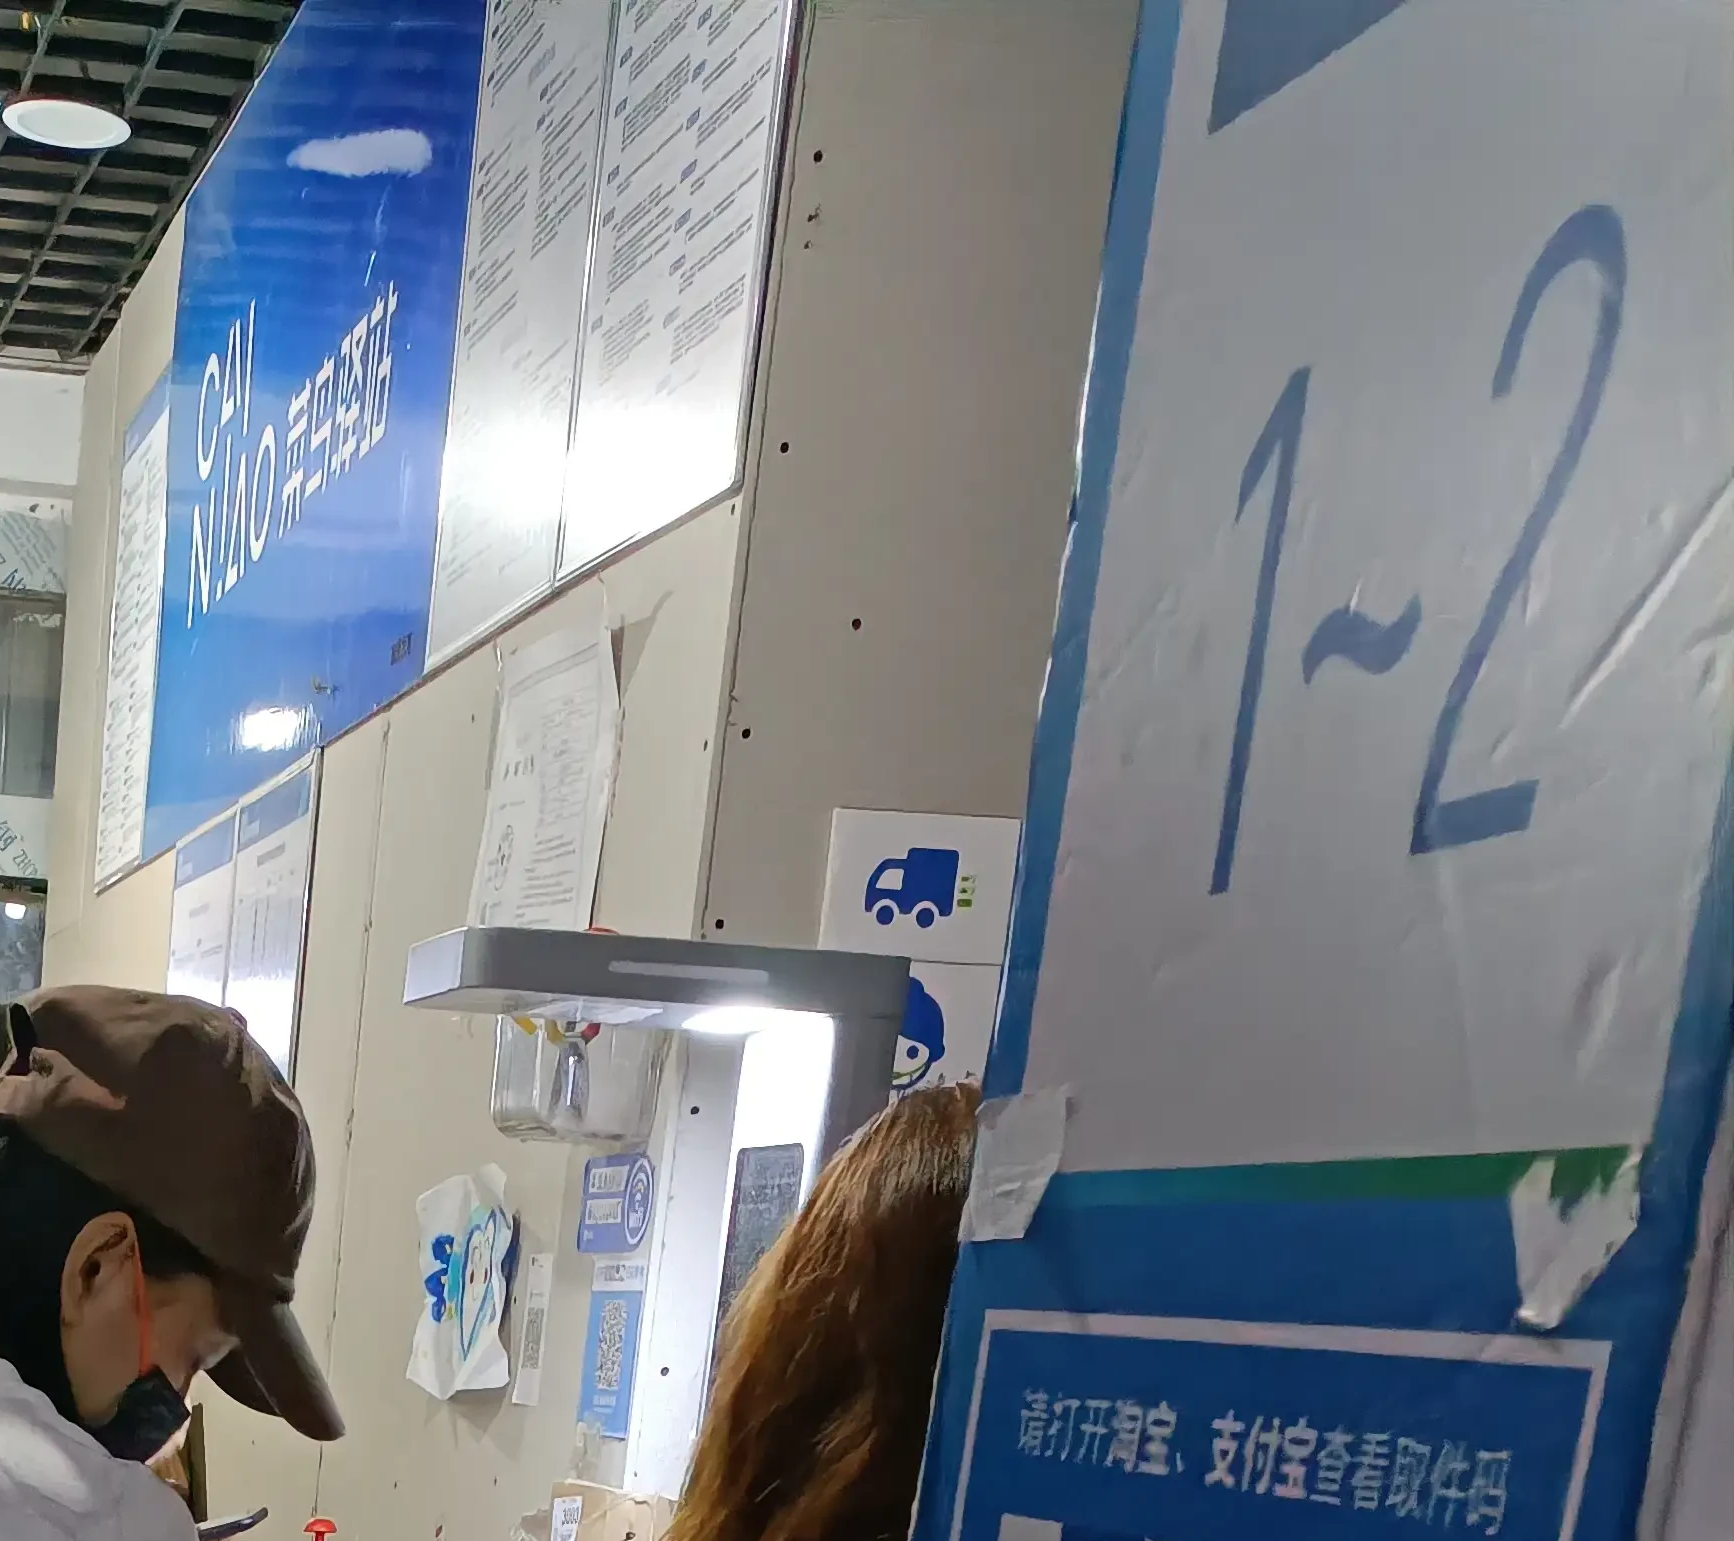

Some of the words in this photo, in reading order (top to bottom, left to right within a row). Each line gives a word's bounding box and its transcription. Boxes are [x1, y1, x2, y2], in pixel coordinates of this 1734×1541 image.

[194, 297, 258, 478] CAI
[278, 280, 399, 541] 菜鸟驿站
[1018, 1387, 1513, 1538] 请打开淘宝、支付宝查看取件码
